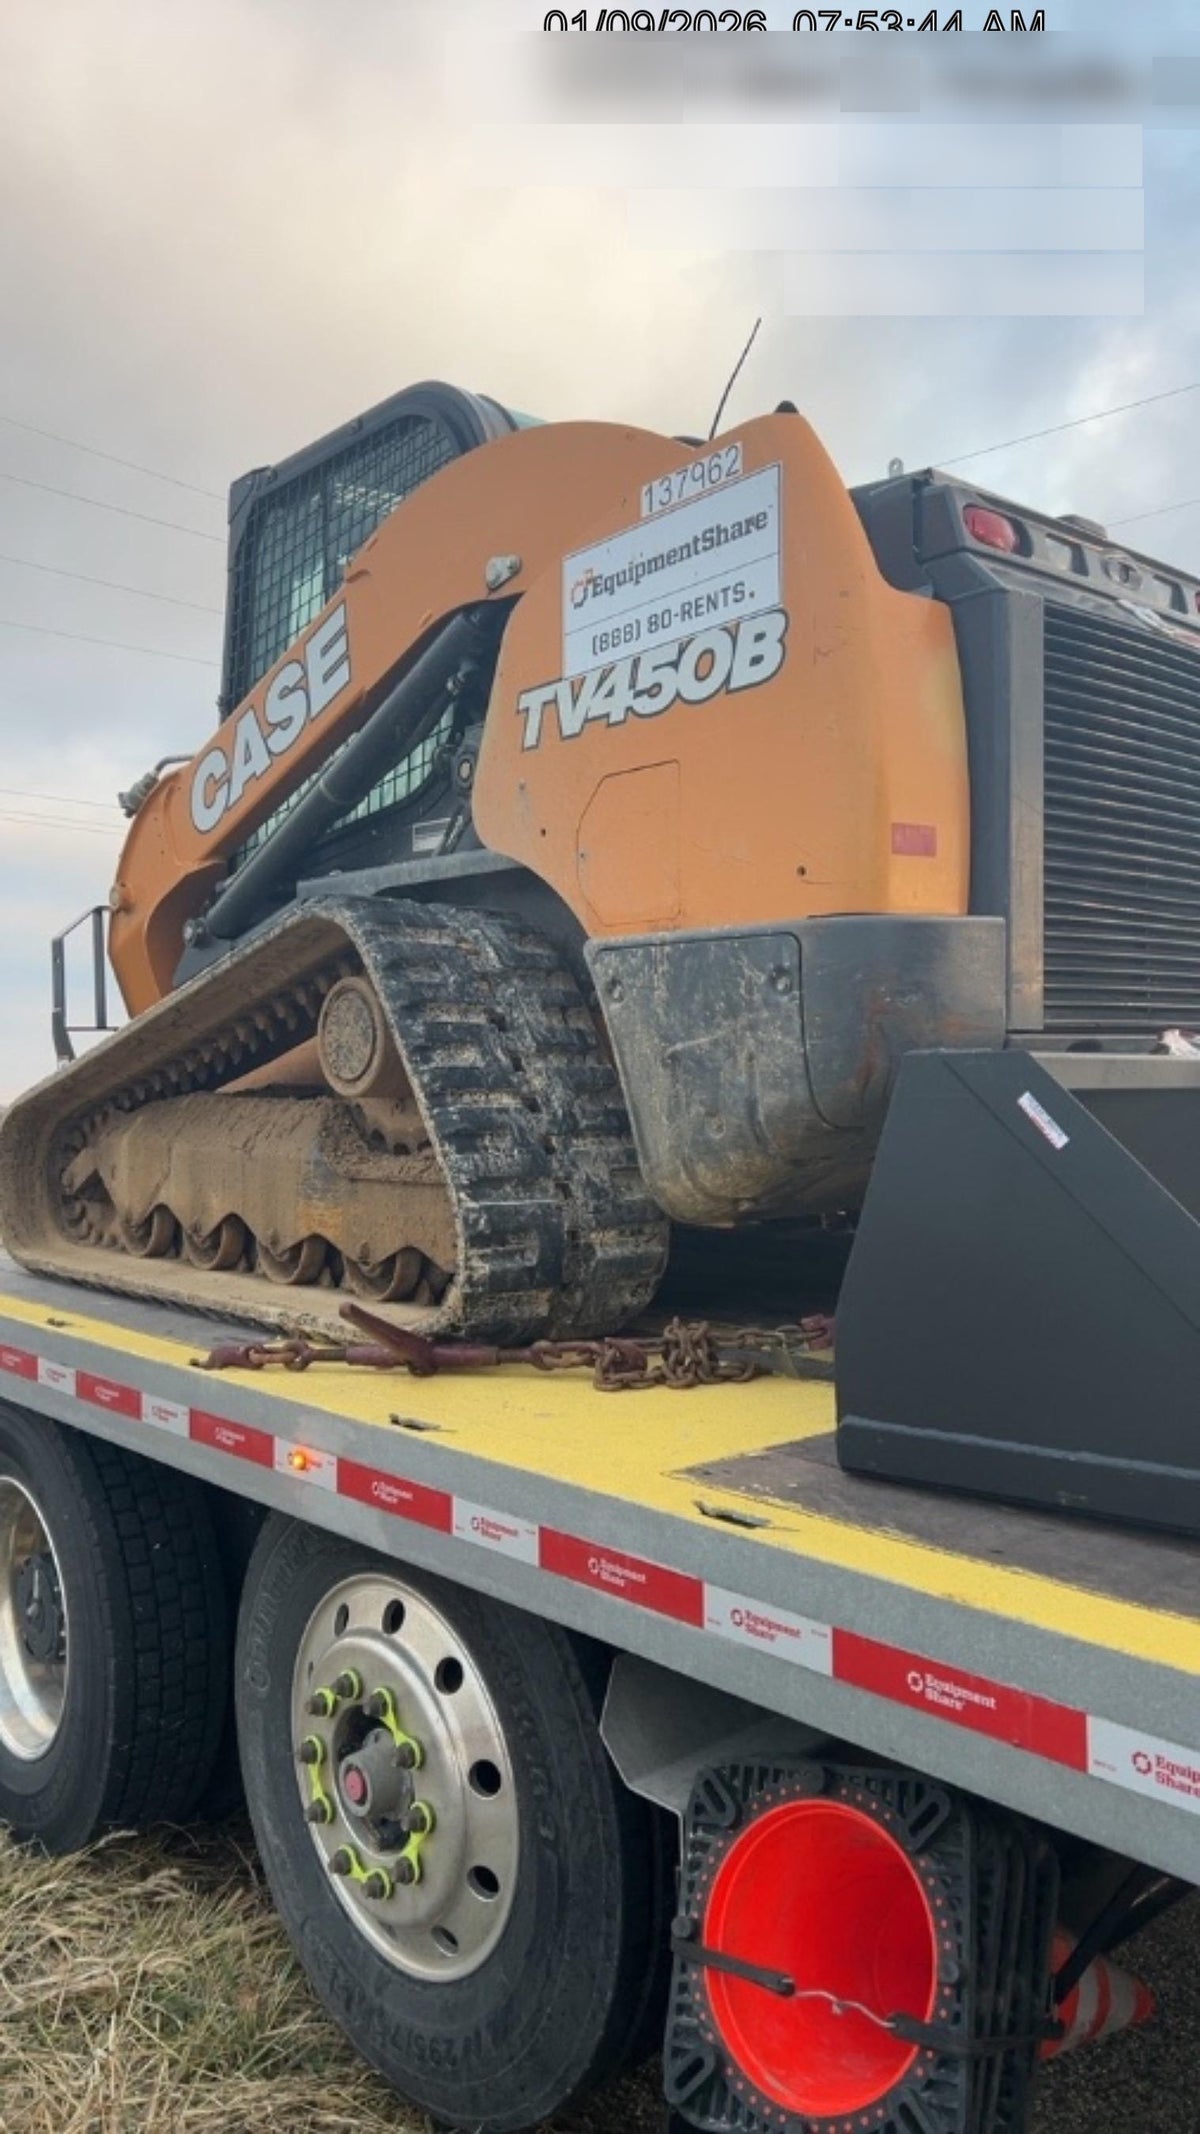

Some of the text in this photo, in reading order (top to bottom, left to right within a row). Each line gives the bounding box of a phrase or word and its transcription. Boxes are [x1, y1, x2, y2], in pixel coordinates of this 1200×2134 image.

[643, 444, 741, 514] 137962
[591, 509, 770, 599] EquipmentShare
[592, 580, 756, 657] (888) 80-RENTS.
[190, 600, 352, 835] CASE
[516, 607, 790, 752] TV450B
[925, 1673, 996, 1710] Equipment
[925, 1687, 964, 1711] Share
